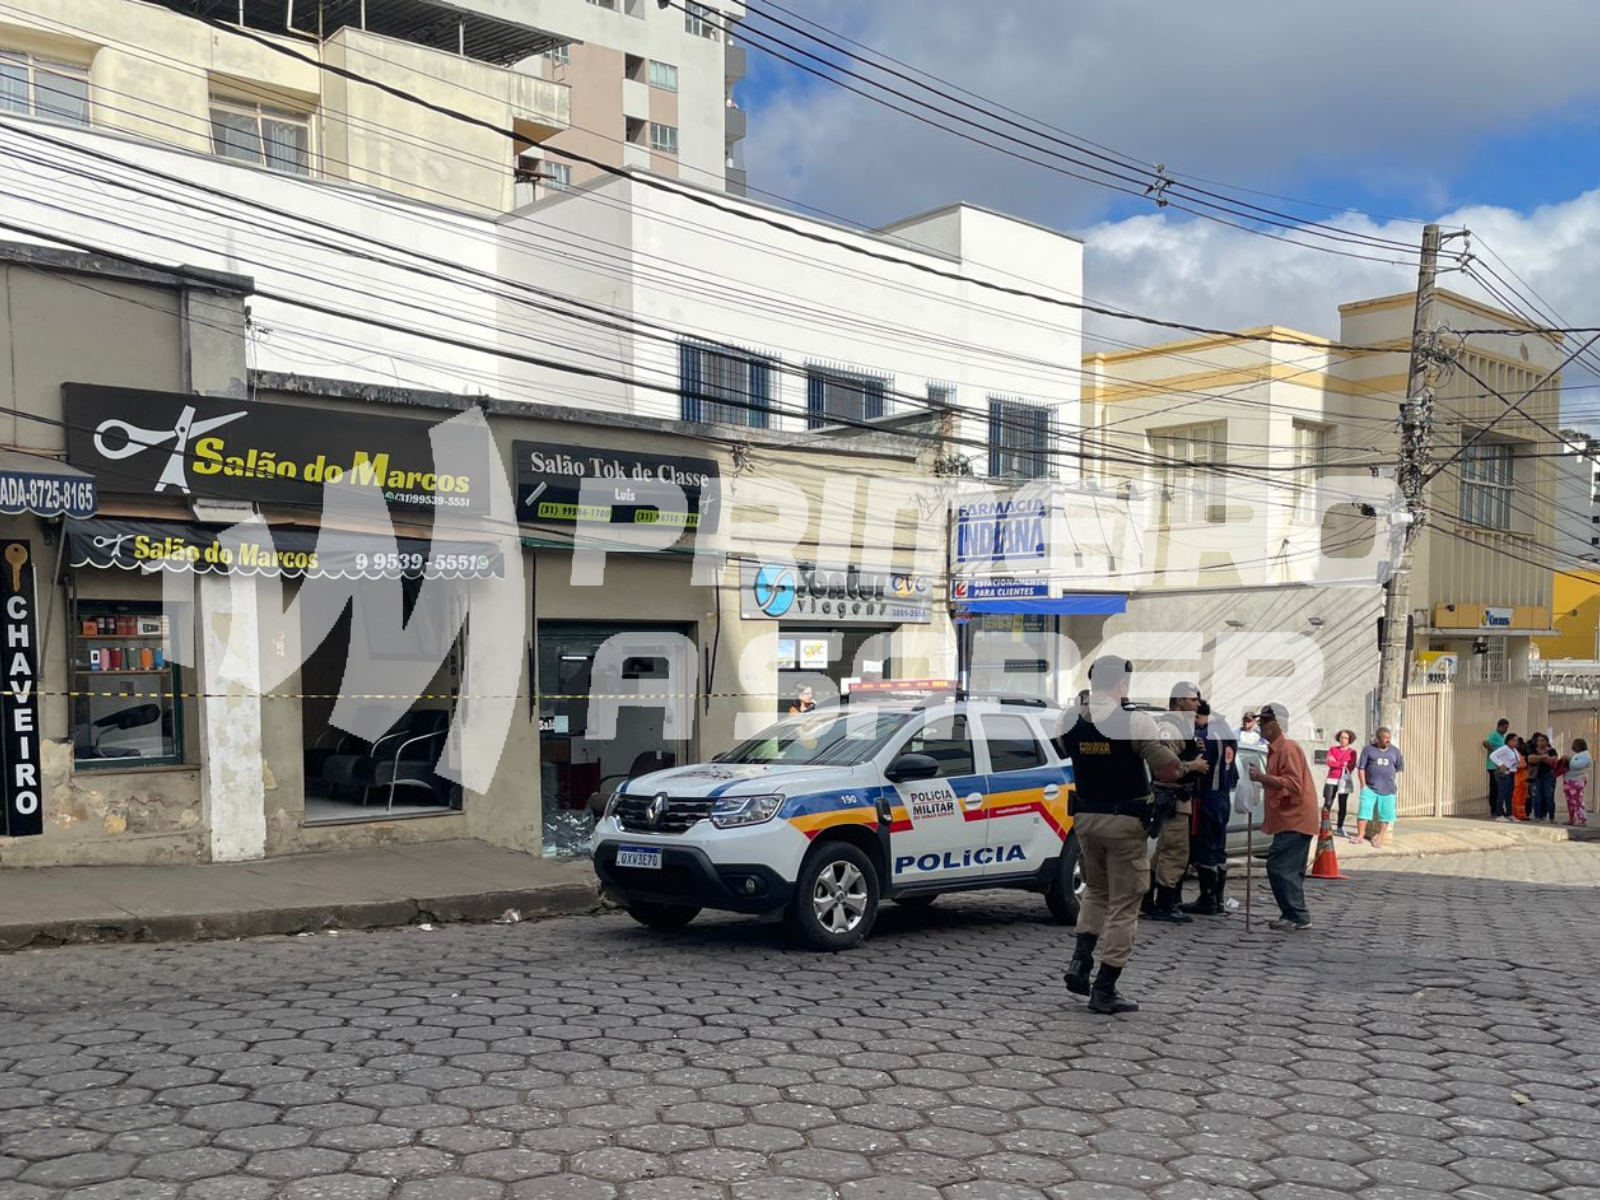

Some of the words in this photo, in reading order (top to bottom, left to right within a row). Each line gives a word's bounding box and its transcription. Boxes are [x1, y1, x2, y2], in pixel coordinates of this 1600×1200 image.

[193, 437, 297, 479] Salão
[304, 455, 344, 484] do
[350, 451, 470, 493] Marcos
[530, 451, 586, 476] Salão
[589, 458, 629, 479] Tok
[632, 463, 653, 482] de
[657, 464, 709, 487] Classe
[134, 535, 200, 563] Salão
[204, 541, 234, 564] do
[238, 543, 319, 569] Marcos
[957, 518, 1044, 557] INDIANA
[974, 588, 996, 597] PARA
[997, 587, 1034, 597] CLIENTES
[7, 596, 38, 815] CHAVEIRO
[841, 795, 857, 804] 190
[912, 802, 954, 816] MILITAR
